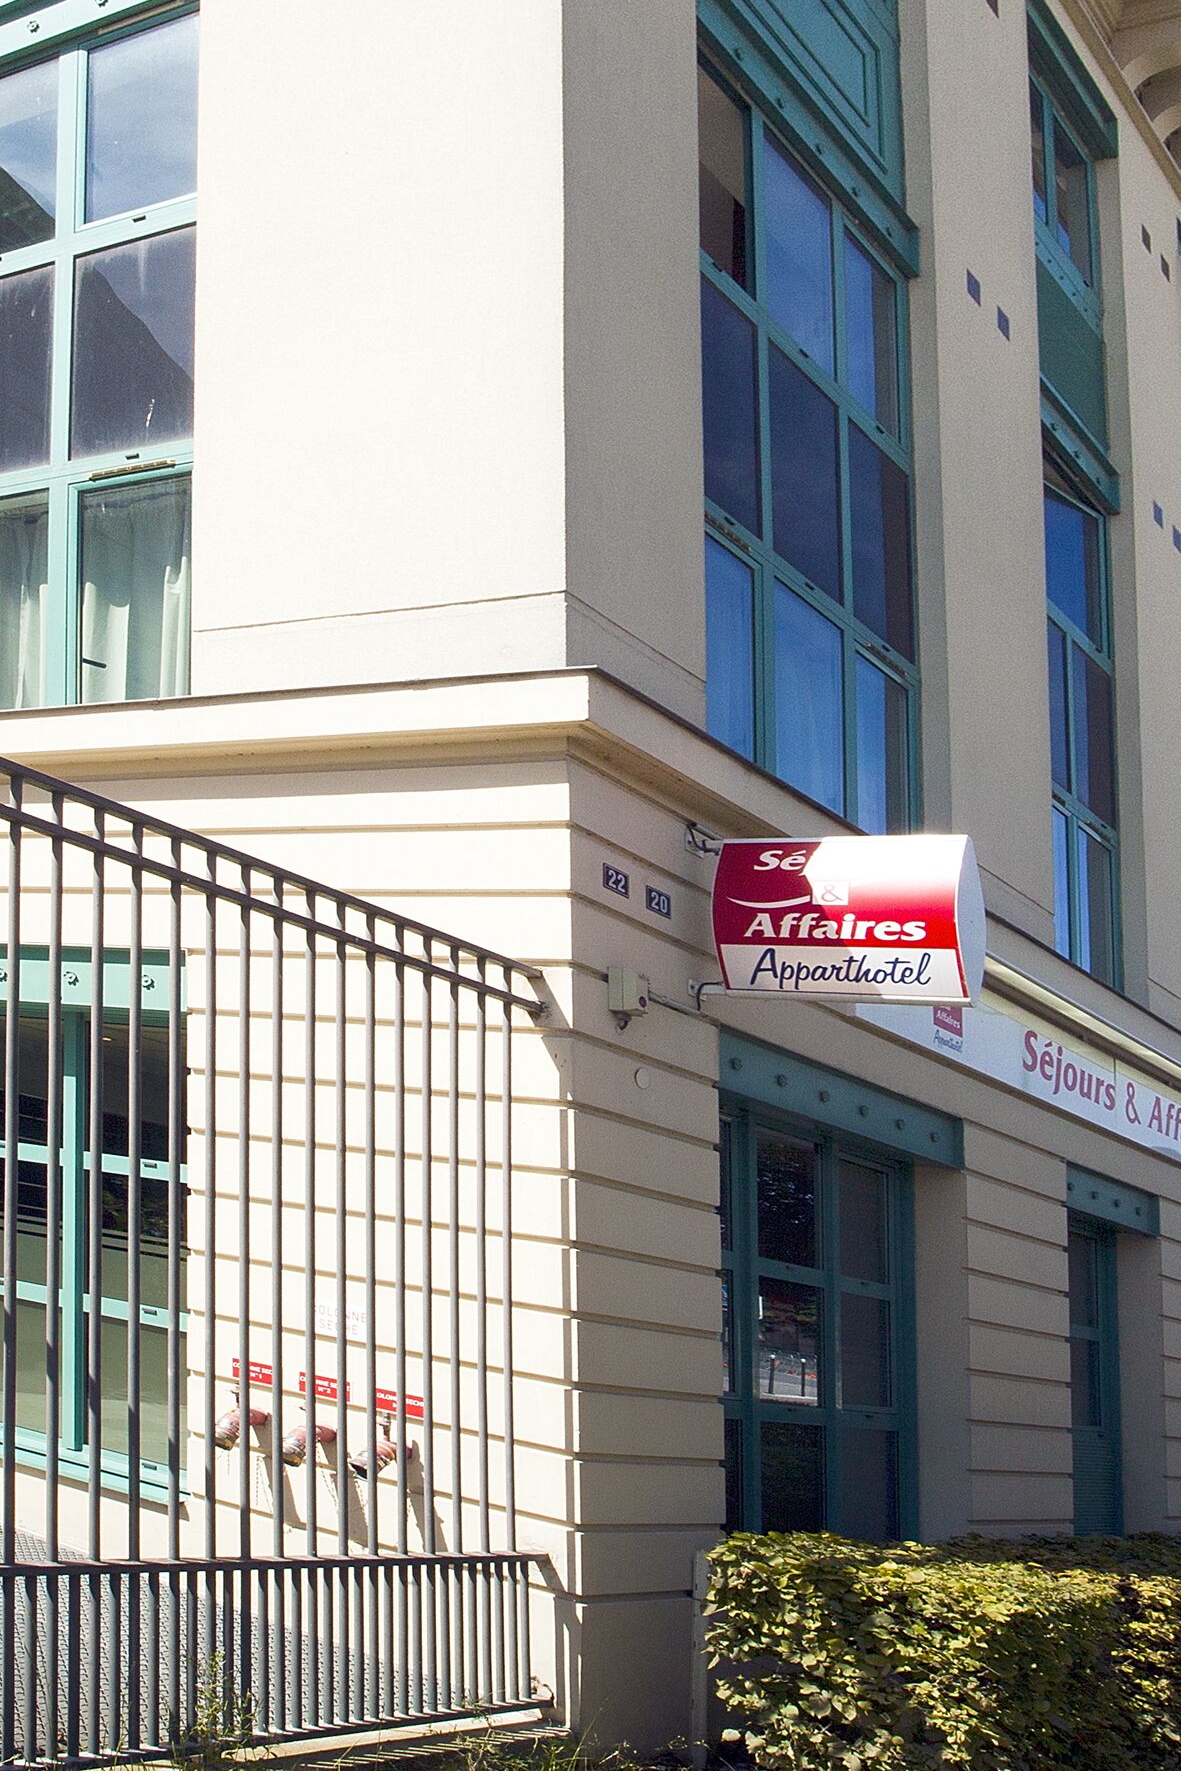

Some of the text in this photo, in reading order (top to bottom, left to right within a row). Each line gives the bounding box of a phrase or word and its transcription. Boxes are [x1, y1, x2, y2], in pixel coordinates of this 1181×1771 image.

[608, 869, 625, 893] 22
[820, 883, 844, 903] &
[651, 891, 668, 913] 20
[743, 912, 927, 941] Affaires
[750, 947, 932, 990] Apparthotel
[1022, 1030, 1116, 1111] Séjours
[1125, 1081, 1142, 1125] &
